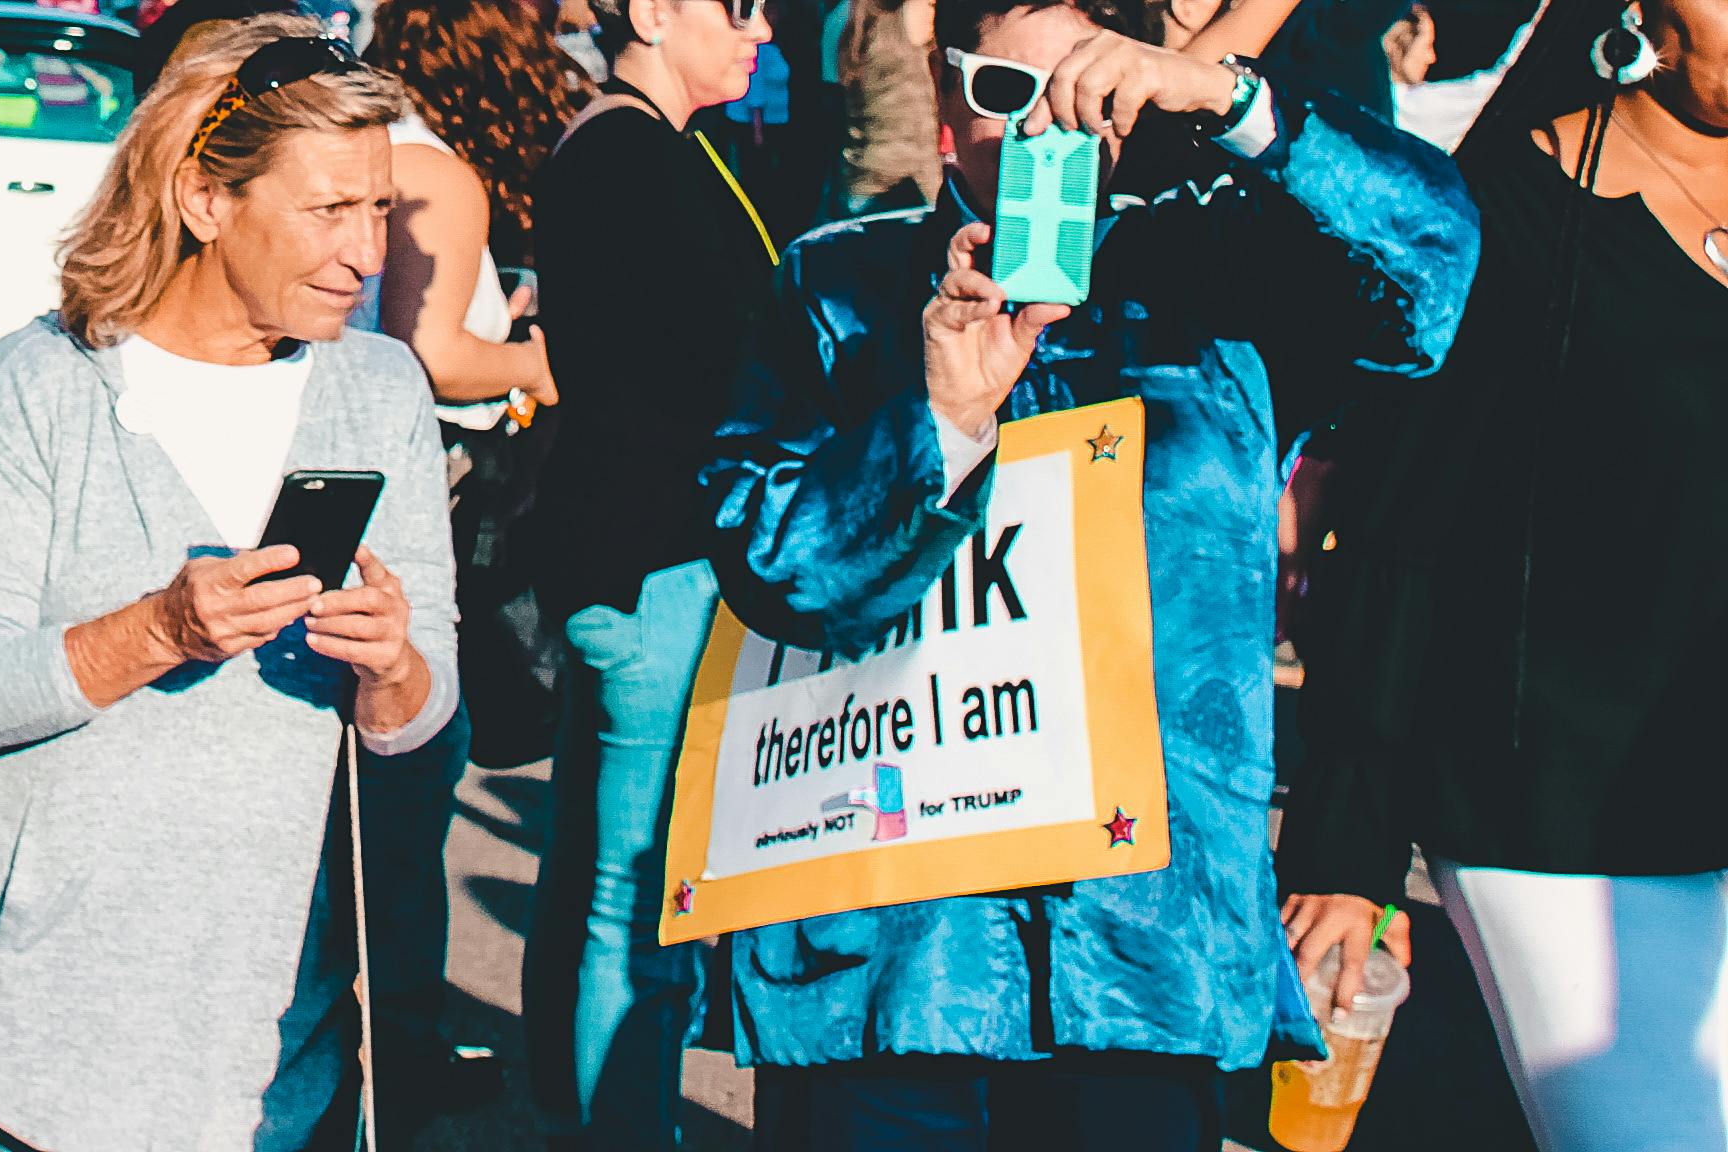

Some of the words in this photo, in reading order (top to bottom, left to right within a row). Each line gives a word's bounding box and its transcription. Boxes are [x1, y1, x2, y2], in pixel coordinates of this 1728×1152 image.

[754, 692, 914, 788] therefore
[929, 673, 943, 746] I
[960, 679, 1038, 742] am
[919, 801, 945, 817] for
[952, 788, 1022, 812] TRUMP
[824, 811, 856, 833] NOT
